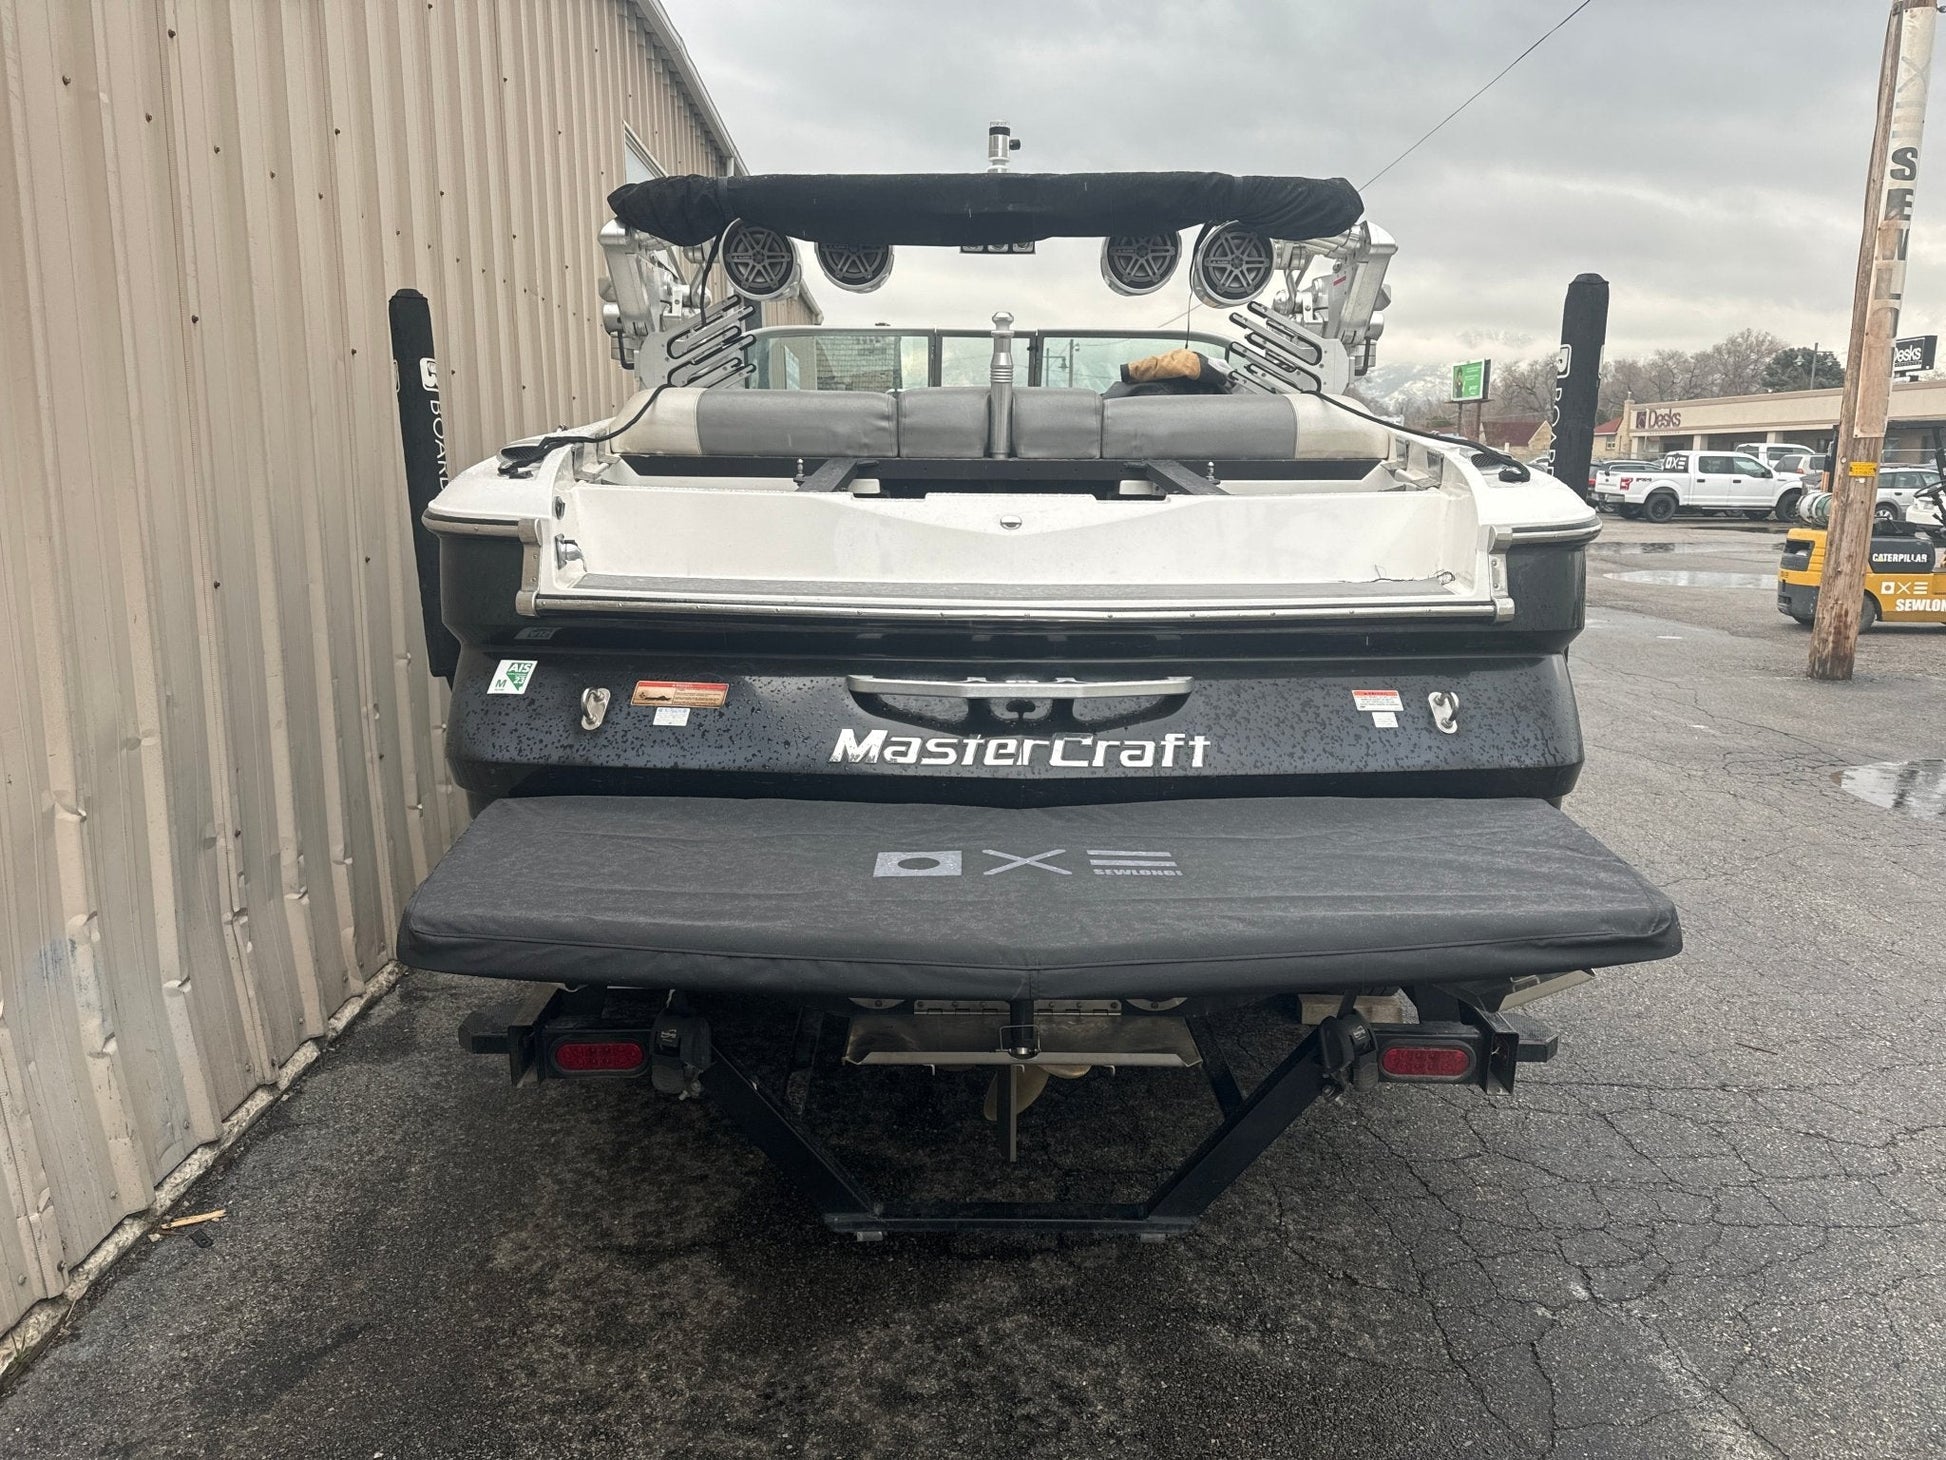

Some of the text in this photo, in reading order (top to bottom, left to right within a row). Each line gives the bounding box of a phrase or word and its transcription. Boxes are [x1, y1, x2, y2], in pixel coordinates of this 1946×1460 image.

[1649, 408, 1681, 428] Desks
[1872, 553, 1928, 563] CATERPILLAR
[508, 663, 532, 673] AIS
[829, 728, 1212, 768] MasterCraft
